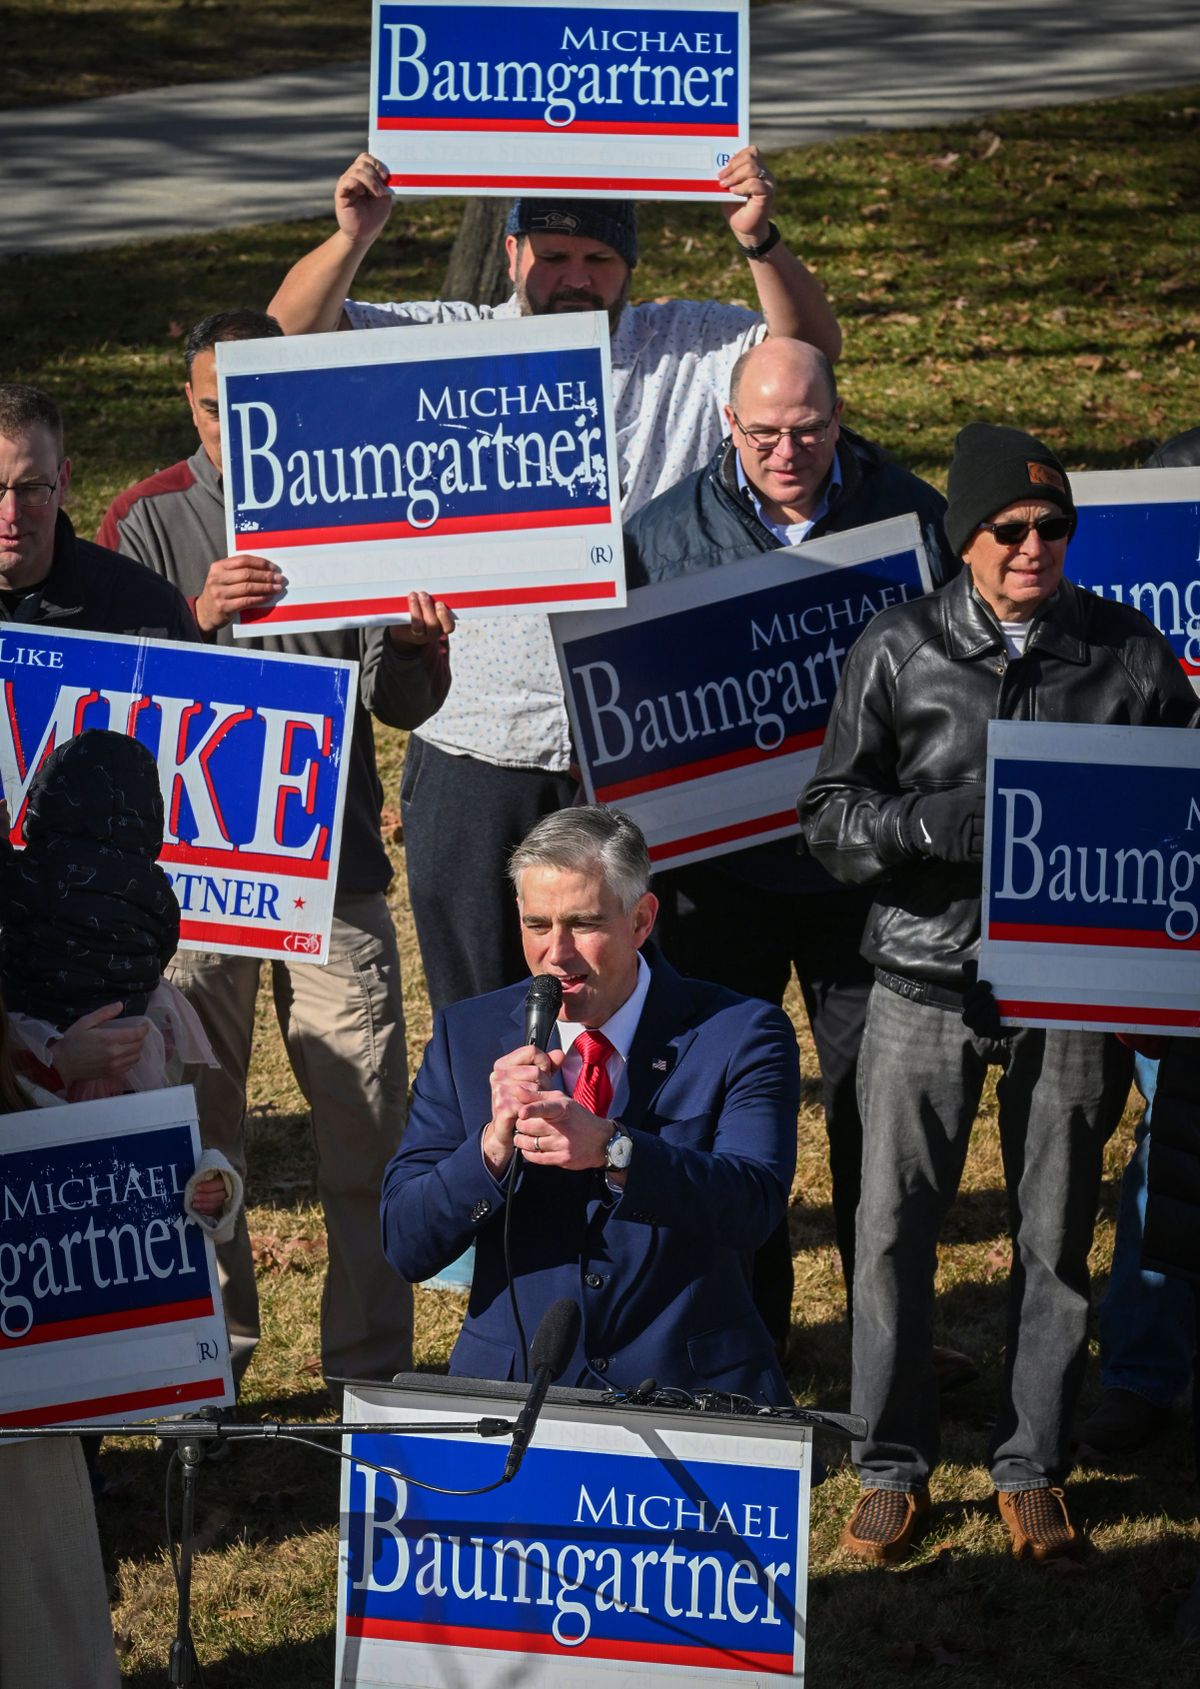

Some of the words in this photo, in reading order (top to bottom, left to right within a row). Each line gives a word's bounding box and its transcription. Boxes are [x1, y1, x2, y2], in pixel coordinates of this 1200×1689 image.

[560, 26, 732, 55] MICHAEL
[382, 23, 734, 128] Baumgartner
[716, 152, 736, 168] (R
[416, 381, 595, 422] MICHAEL
[231, 401, 602, 529] Baumgartner
[590, 543, 613, 565] (R)
[0, 638, 64, 669] LIKE
[169, 871, 281, 921] TNER
[283, 934, 319, 953] (R)
[3, 1163, 185, 1221] MICHAEL
[0, 1215, 197, 1338] gartner
[574, 1483, 789, 1541] MICHAEL
[353, 1463, 791, 1647] Baumgartner
